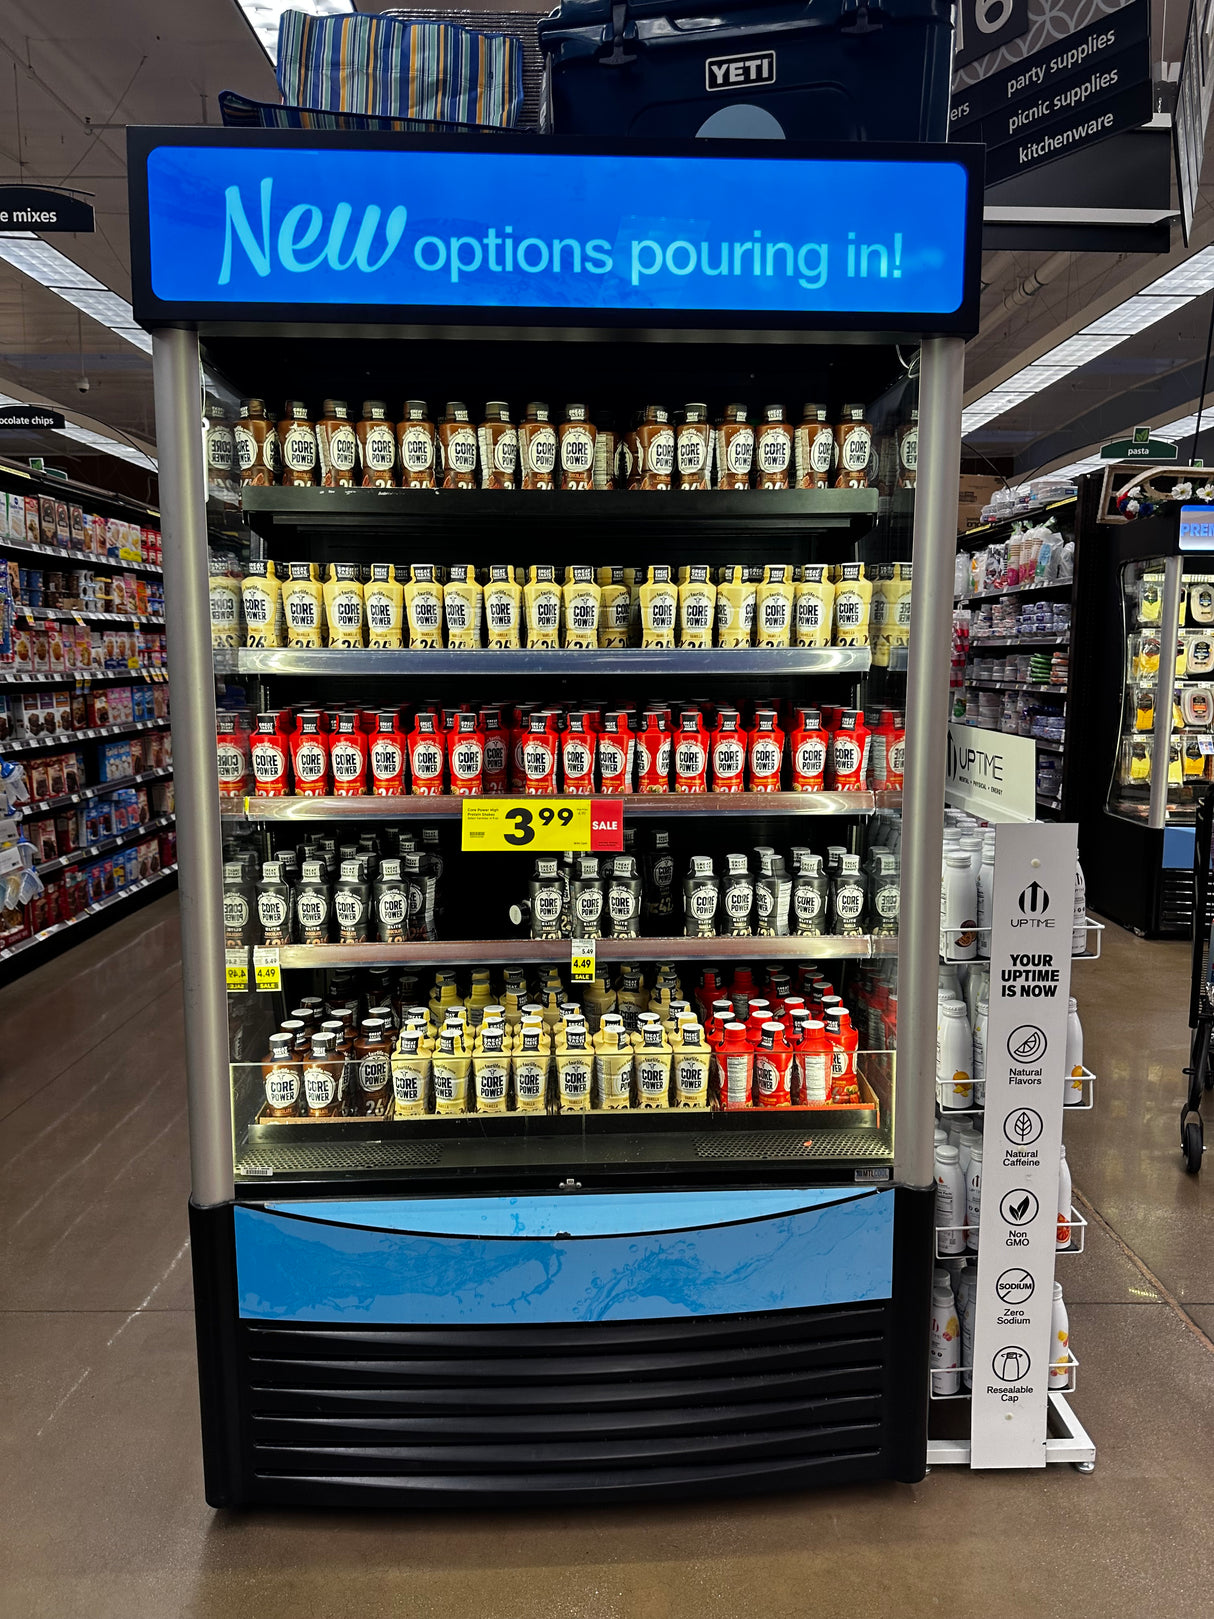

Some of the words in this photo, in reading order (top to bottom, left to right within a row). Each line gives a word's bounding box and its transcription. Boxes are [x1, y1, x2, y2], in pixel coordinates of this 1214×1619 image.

[1007, 63, 1046, 97] party
[1050, 30, 1116, 73] supplies
[711, 59, 769, 84] YETI
[1009, 101, 1050, 134] picnic
[1053, 68, 1118, 110] supplies
[950, 102, 969, 120] ers
[1019, 113, 1113, 163] kitchenware
[13, 208, 57, 222] mixes
[217, 177, 408, 285] New
[414, 225, 613, 283] options
[630, 230, 829, 290] pouring
[847, 232, 904, 278] in!
[32, 416, 54, 426] chips
[292, 440, 314, 454] CORE
[337, 440, 354, 454] CORE
[372, 440, 391, 453] CORE
[408, 440, 428, 454] CORE
[455, 442, 475, 455] CORE
[566, 442, 588, 455] CORE
[681, 443, 700, 456] CORE
[764, 443, 786, 456] CORE
[850, 441, 867, 454] CORE
[1128, 446, 1149, 456] pasta
[292, 454, 314, 464] POWER
[337, 454, 353, 464] POWER
[372, 454, 391, 464] POWER
[408, 454, 428, 464] POWER
[456, 456, 474, 465] POWER
[566, 456, 588, 465] POWER
[681, 456, 700, 467] POWER
[765, 456, 785, 466] POWER
[849, 454, 866, 464] POWER
[245, 600, 265, 611] CORE
[290, 603, 314, 615] CORE
[338, 604, 360, 615] CORE
[370, 605, 390, 616] CORE
[415, 604, 437, 616] CORE
[491, 603, 510, 616] CORE
[538, 603, 557, 616] CORE
[653, 604, 672, 616] CORE
[765, 605, 785, 616] CORE
[839, 603, 859, 614] CORE
[246, 612, 266, 620] POWER
[686, 606, 708, 617] CORE
[292, 615, 314, 625] POWER
[338, 615, 360, 625] POWER
[372, 616, 391, 625] POWER
[416, 616, 438, 625] POWER
[492, 616, 511, 625] POWER
[538, 616, 556, 625] POWER
[653, 616, 672, 626] POWER
[687, 617, 708, 626] POWER
[765, 617, 785, 626] POWER
[839, 614, 858, 623] POWER
[256, 755, 277, 766] CORE
[301, 754, 321, 765] CORE
[375, 752, 396, 763] CORE
[418, 752, 438, 764] CORE
[458, 752, 479, 763] CORE
[527, 753, 546, 764] CORE
[567, 752, 584, 763] CORE
[679, 752, 699, 763] CORE
[718, 751, 739, 762] CORE
[756, 751, 775, 762] CORE
[802, 750, 822, 761] CORE
[256, 766, 278, 775] POWER
[302, 765, 321, 774] POWER
[376, 764, 396, 772] POWER
[418, 764, 438, 773] POWER
[458, 764, 479, 773] POWER
[528, 764, 546, 773] POWER
[567, 764, 584, 772] POWER
[679, 763, 699, 772] POWER
[718, 762, 739, 771] POWER
[756, 762, 775, 770] POWER
[802, 762, 821, 770] POWER
[592, 821, 618, 830] SALE
[540, 898, 557, 908] CORE
[611, 897, 629, 907] CORE
[696, 896, 715, 906] CORE
[732, 894, 749, 904] CORE
[842, 895, 859, 905] CORE
[262, 903, 280, 913] CORE
[338, 903, 356, 913] CORE
[384, 900, 403, 910] CORE
[262, 913, 281, 921] POWER
[339, 913, 356, 921] POWER
[385, 910, 403, 919] POWER
[574, 960, 591, 968] 4.49
[1010, 954, 1052, 966] YOUR
[258, 969, 275, 977] 4.49
[1001, 970, 1060, 982] UPTIME
[1002, 984, 1016, 997] IS
[1020, 984, 1058, 998] NOW
[364, 1064, 386, 1076] CORE
[642, 1069, 663, 1081] CORE
[681, 1068, 701, 1080] CORE
[1009, 1068, 1042, 1076] Natural
[365, 1075, 385, 1085] POWER
[395, 1076, 417, 1089] CORE
[481, 1075, 503, 1087] CORE
[520, 1074, 540, 1086] CORE
[565, 1072, 587, 1083] CORE
[1009, 1077, 1042, 1085] Flavors
[271, 1080, 294, 1092] CORE
[308, 1080, 329, 1091] CORE
[565, 1084, 586, 1093] POWER
[643, 1081, 663, 1090] POWER
[681, 1080, 701, 1089] POWER
[396, 1089, 418, 1098] POWER
[481, 1087, 503, 1097] POWER
[520, 1086, 539, 1095] POWER
[272, 1092, 294, 1101] POWER
[308, 1092, 329, 1101] POWER
[1005, 1150, 1038, 1158] Natural
[1003, 1158, 1040, 1167] Caffeine
[1009, 1230, 1027, 1238] Non
[1006, 1238, 1029, 1246] GMO
[1000, 1394, 1019, 1403] Cap
